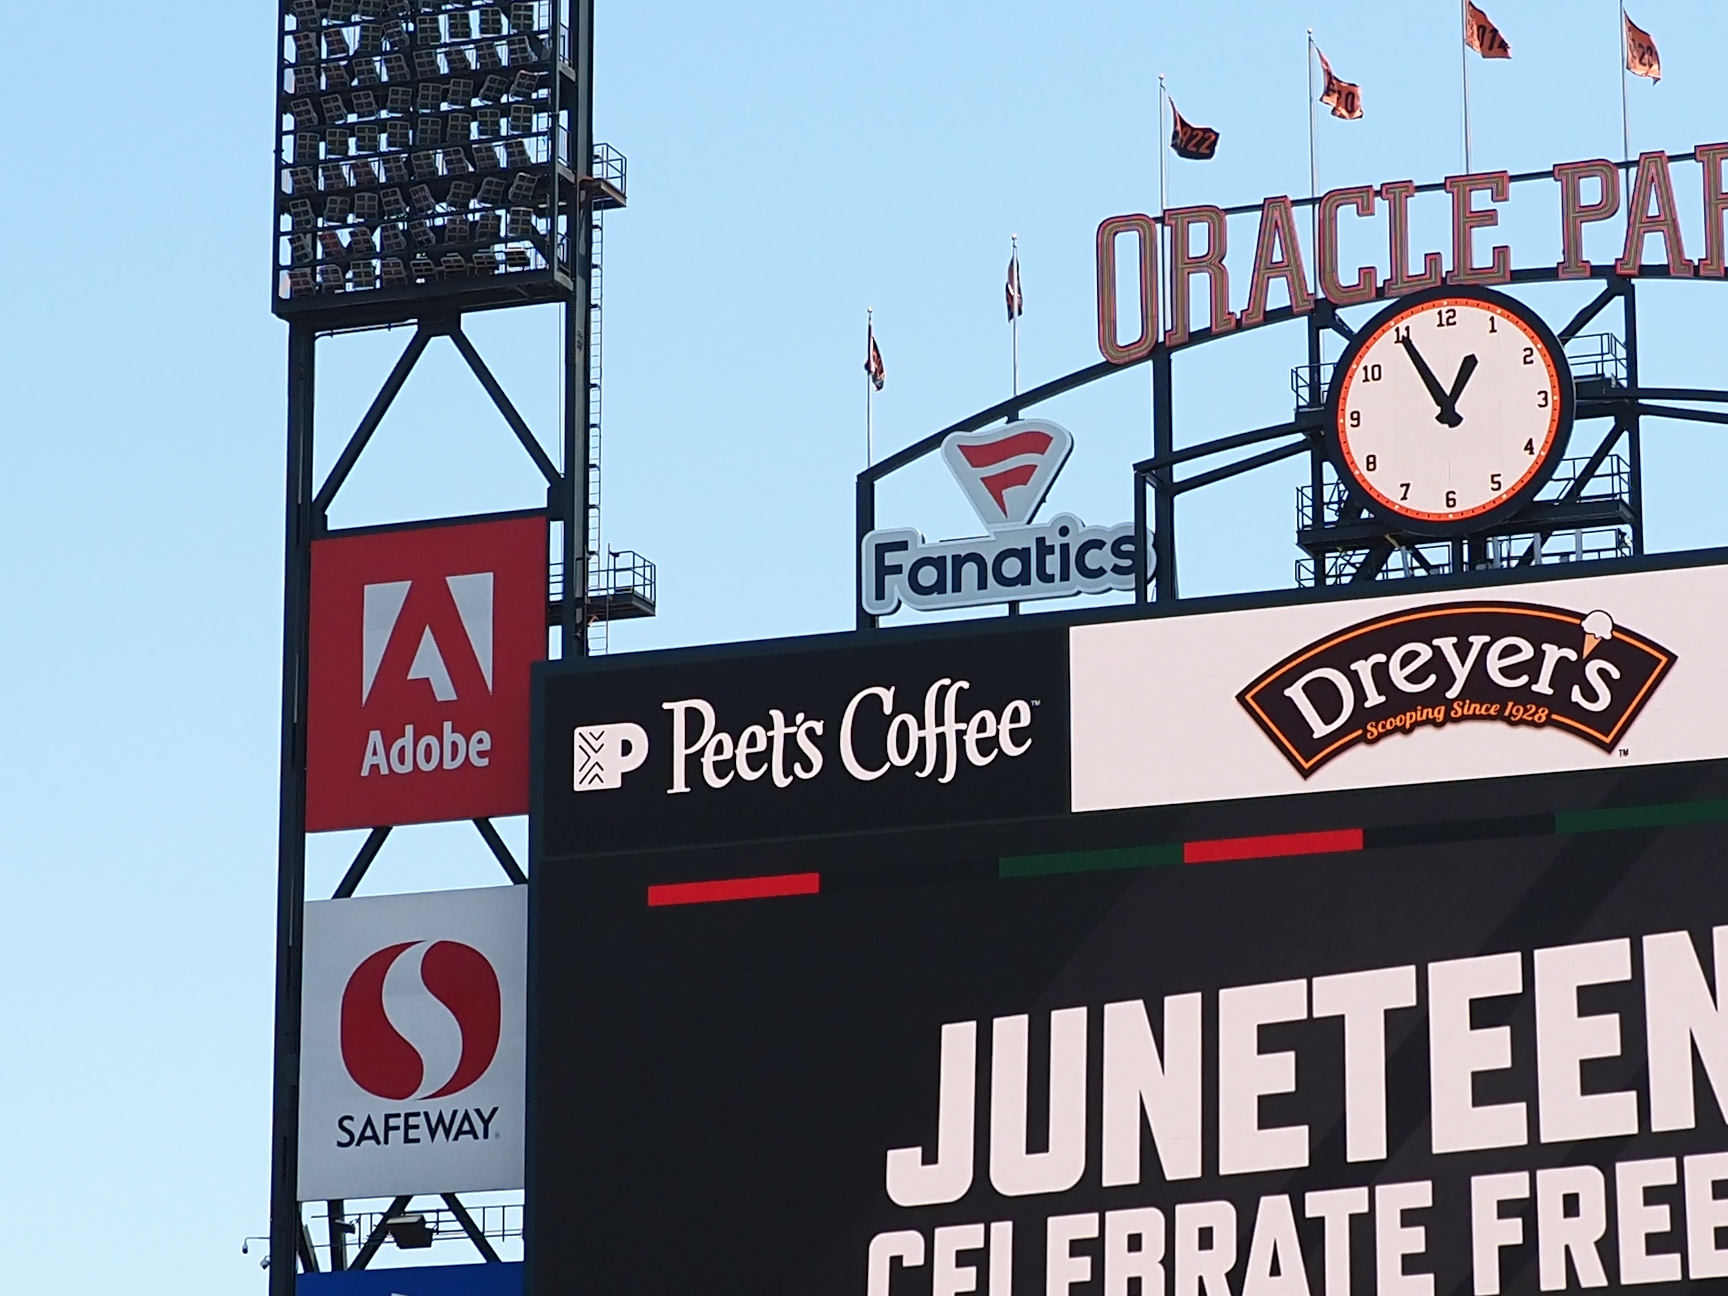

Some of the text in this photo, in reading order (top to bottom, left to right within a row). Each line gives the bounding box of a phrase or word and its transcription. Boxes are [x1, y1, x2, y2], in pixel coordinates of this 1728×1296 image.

[1096, 170, 1510, 365] ORACLE
[1436, 309, 1457, 327] 12
[1488, 316, 1498, 333] 1
[1523, 348, 1534, 365] 2
[1362, 364, 1382, 383] 10
[1537, 391, 1548, 408] 3
[1350, 411, 1361, 428] 9
[1523, 438, 1535, 455] 4
[1366, 454, 1377, 472] 8
[1490, 473, 1502, 491] 5
[1399, 483, 1411, 501] 7
[1445, 490, 1457, 508] 6
[874, 524, 1136, 602] Fanatics
[1365, 700, 1549, 740] Scooping Since 1928
[662, 698, 824, 794] Peet's
[839, 677, 1033, 784] Coffee
[360, 720, 492, 777] Adobe
[336, 1106, 500, 1149] SAFEWAY
